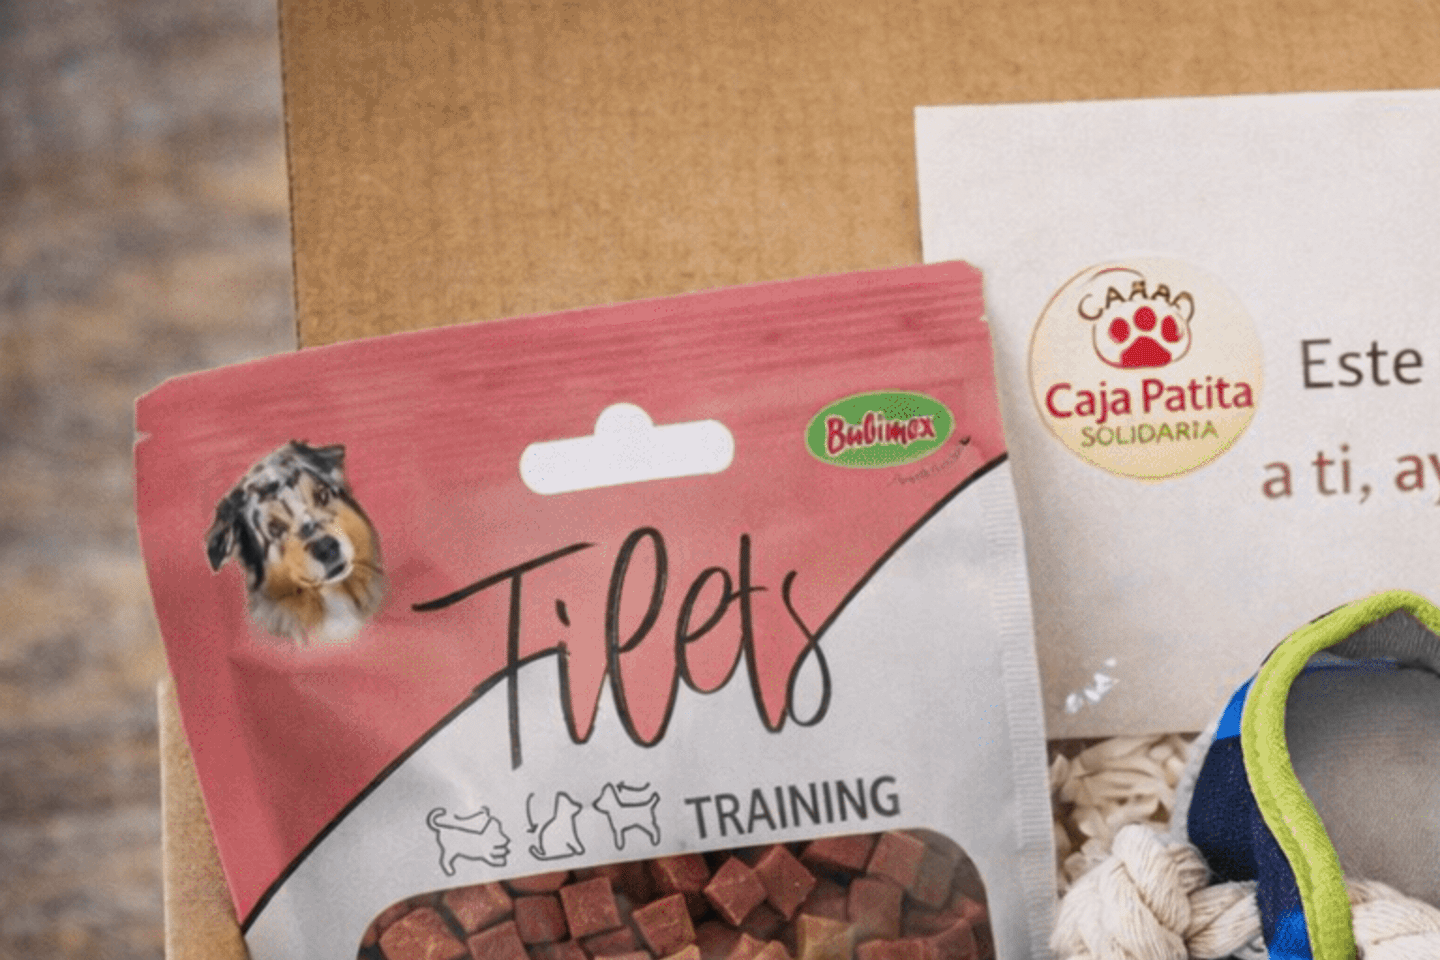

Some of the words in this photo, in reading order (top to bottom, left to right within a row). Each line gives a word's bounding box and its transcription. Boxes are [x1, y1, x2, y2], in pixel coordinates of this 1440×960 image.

[1301, 338, 1423, 389] Este
[1045, 380, 1131, 424] Caja
[1142, 376, 1254, 413] Patita
[1081, 420, 1219, 447] SOLIDARIA
[1261, 460, 1292, 498] a
[1312, 443, 1372, 502] ti,
[685, 776, 901, 839] TRAINING
